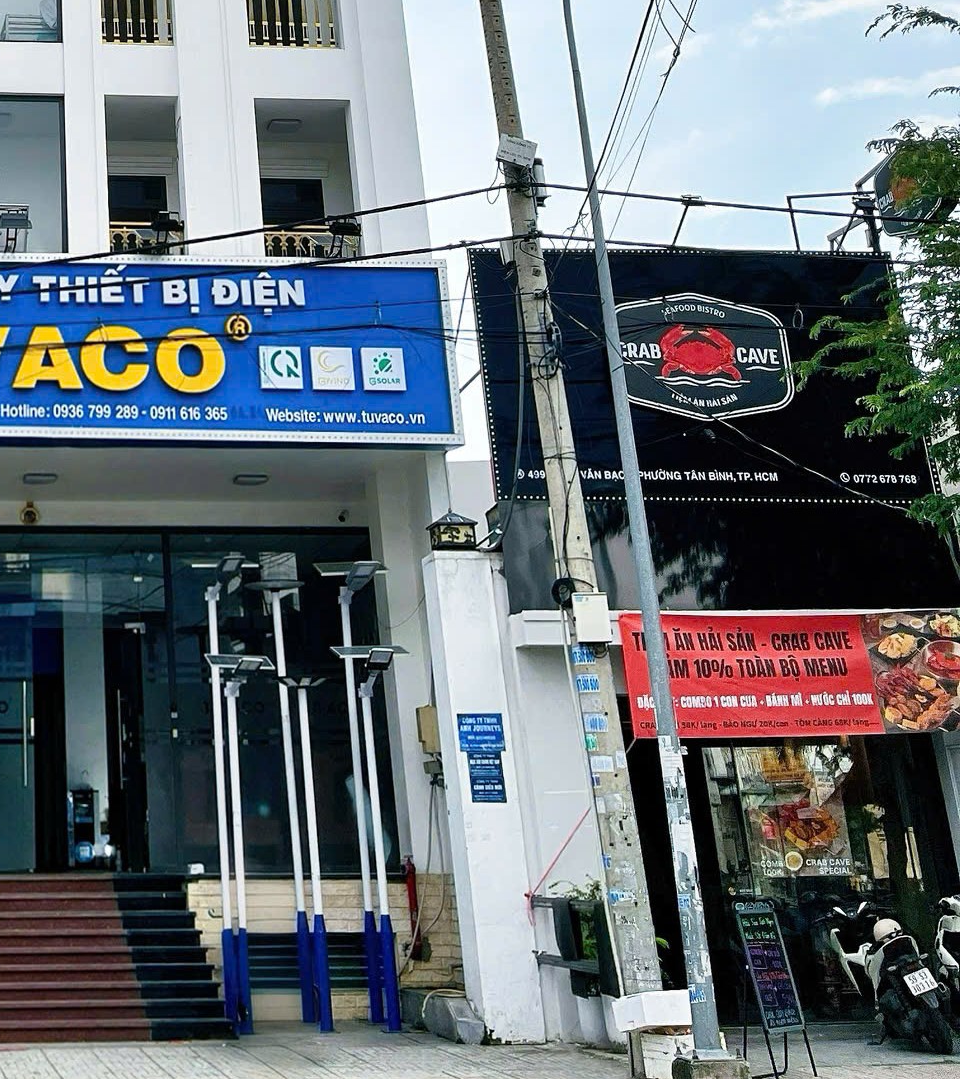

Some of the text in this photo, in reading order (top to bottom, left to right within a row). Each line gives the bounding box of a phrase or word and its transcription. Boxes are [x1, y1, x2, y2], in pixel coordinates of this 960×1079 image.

[32, 265, 150, 303] THIẾT
[162, 278, 200, 313] BỊ
[211, 272, 306, 315] ĐIỆN
[697, 305, 725, 318] BISTRO
[620, 342, 780, 365] CRAB CAVE
[0, 403, 50, 419] Hotline:
[53, 404, 84, 419] 0936
[88, 405, 111, 419] 799
[115, 405, 139, 420] 289
[150, 406, 176, 420] 0911
[180, 406, 201, 421] 616
[205, 407, 228, 421] 365
[265, 407, 321, 423] Website:
[323, 409, 426, 425] www.tuvaco.vn
[580, 470, 602, 480] VĂN
[639, 469, 682, 481] PHƯỜNG
[684, 470, 706, 481] TÂN
[755, 473, 778, 482] HCM
[853, 474, 917, 484] 0772 678 768
[672, 627, 853, 651] ĂN HẢI SẢN CRAB CAVE
[693, 654, 848, 682] 10% TOÀN BỘ MENU
[680, 696, 713, 708] COMBO
[720, 696, 738, 708] CON
[740, 695, 758, 707] CUA
